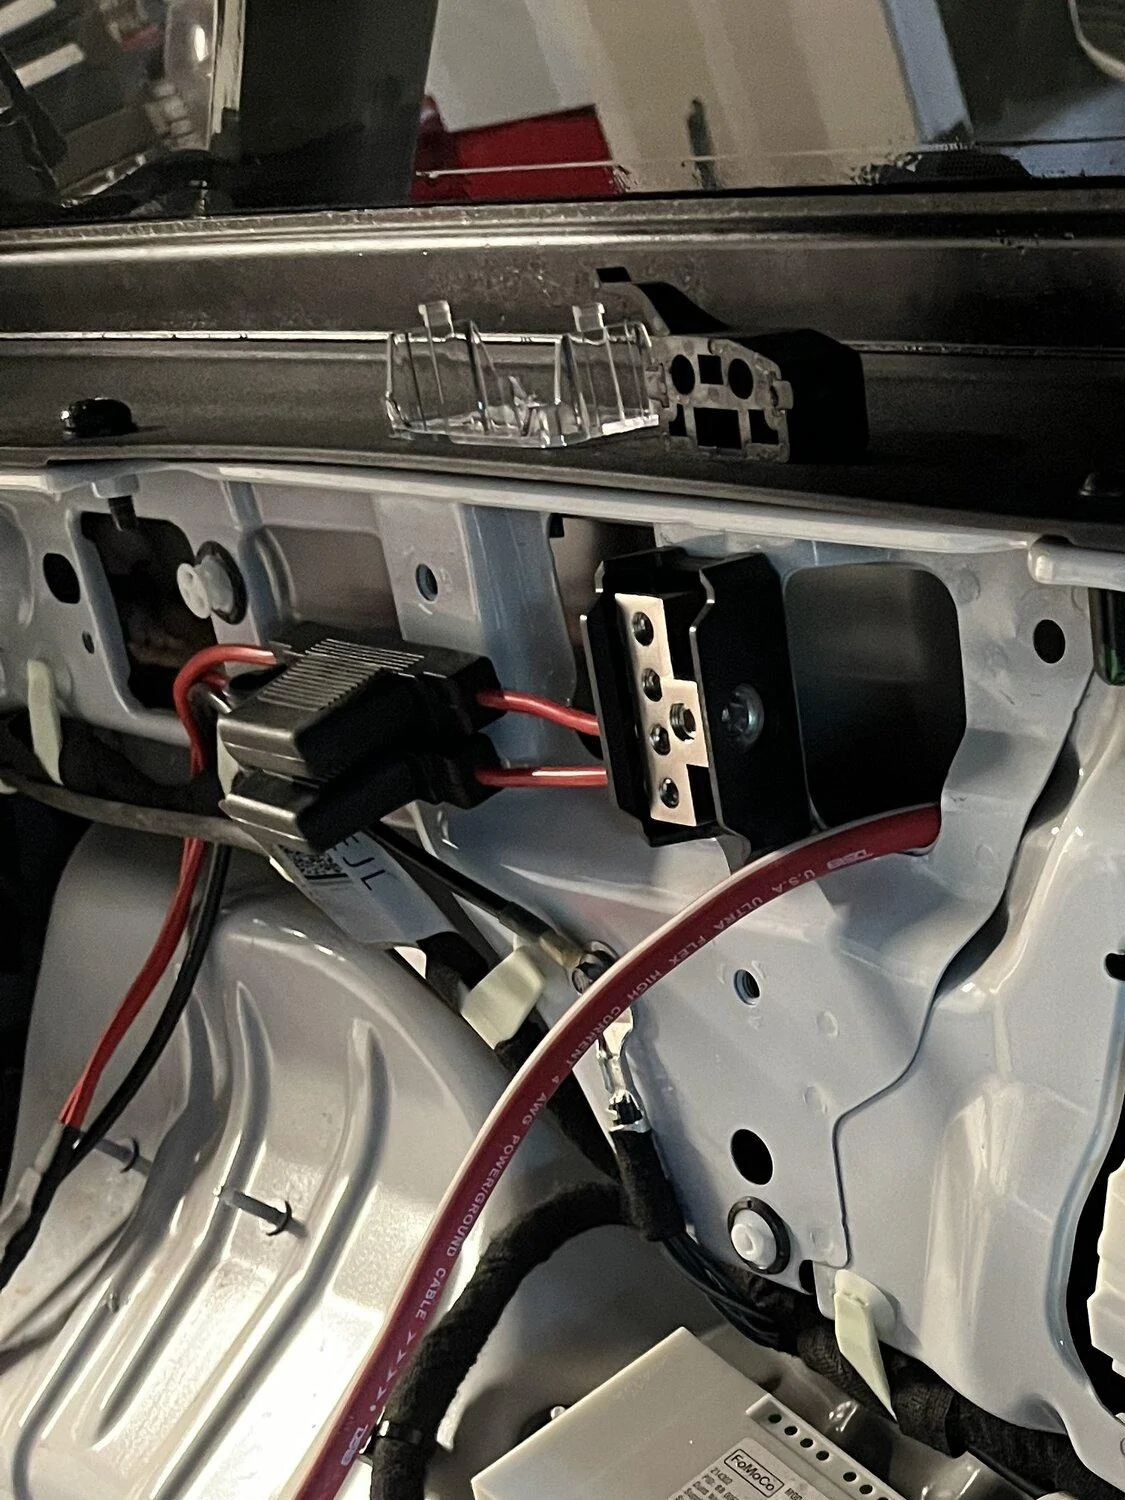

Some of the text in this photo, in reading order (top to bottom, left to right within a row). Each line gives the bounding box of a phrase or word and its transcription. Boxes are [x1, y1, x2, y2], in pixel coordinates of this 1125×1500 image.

[713, 896, 763, 930] ULTRA
[668, 935, 707, 967] FLEX
[626, 970, 662, 1001] HIGH
[566, 1006, 621, 1065] CURRENT
[551, 1075, 561, 1085] 4
[522, 1092, 549, 1125] AWG
[446, 1134, 521, 1258] POWER/GROUND
[416, 1267, 447, 1321] CABLE
[729, 1453, 778, 1492] FoMoCo
